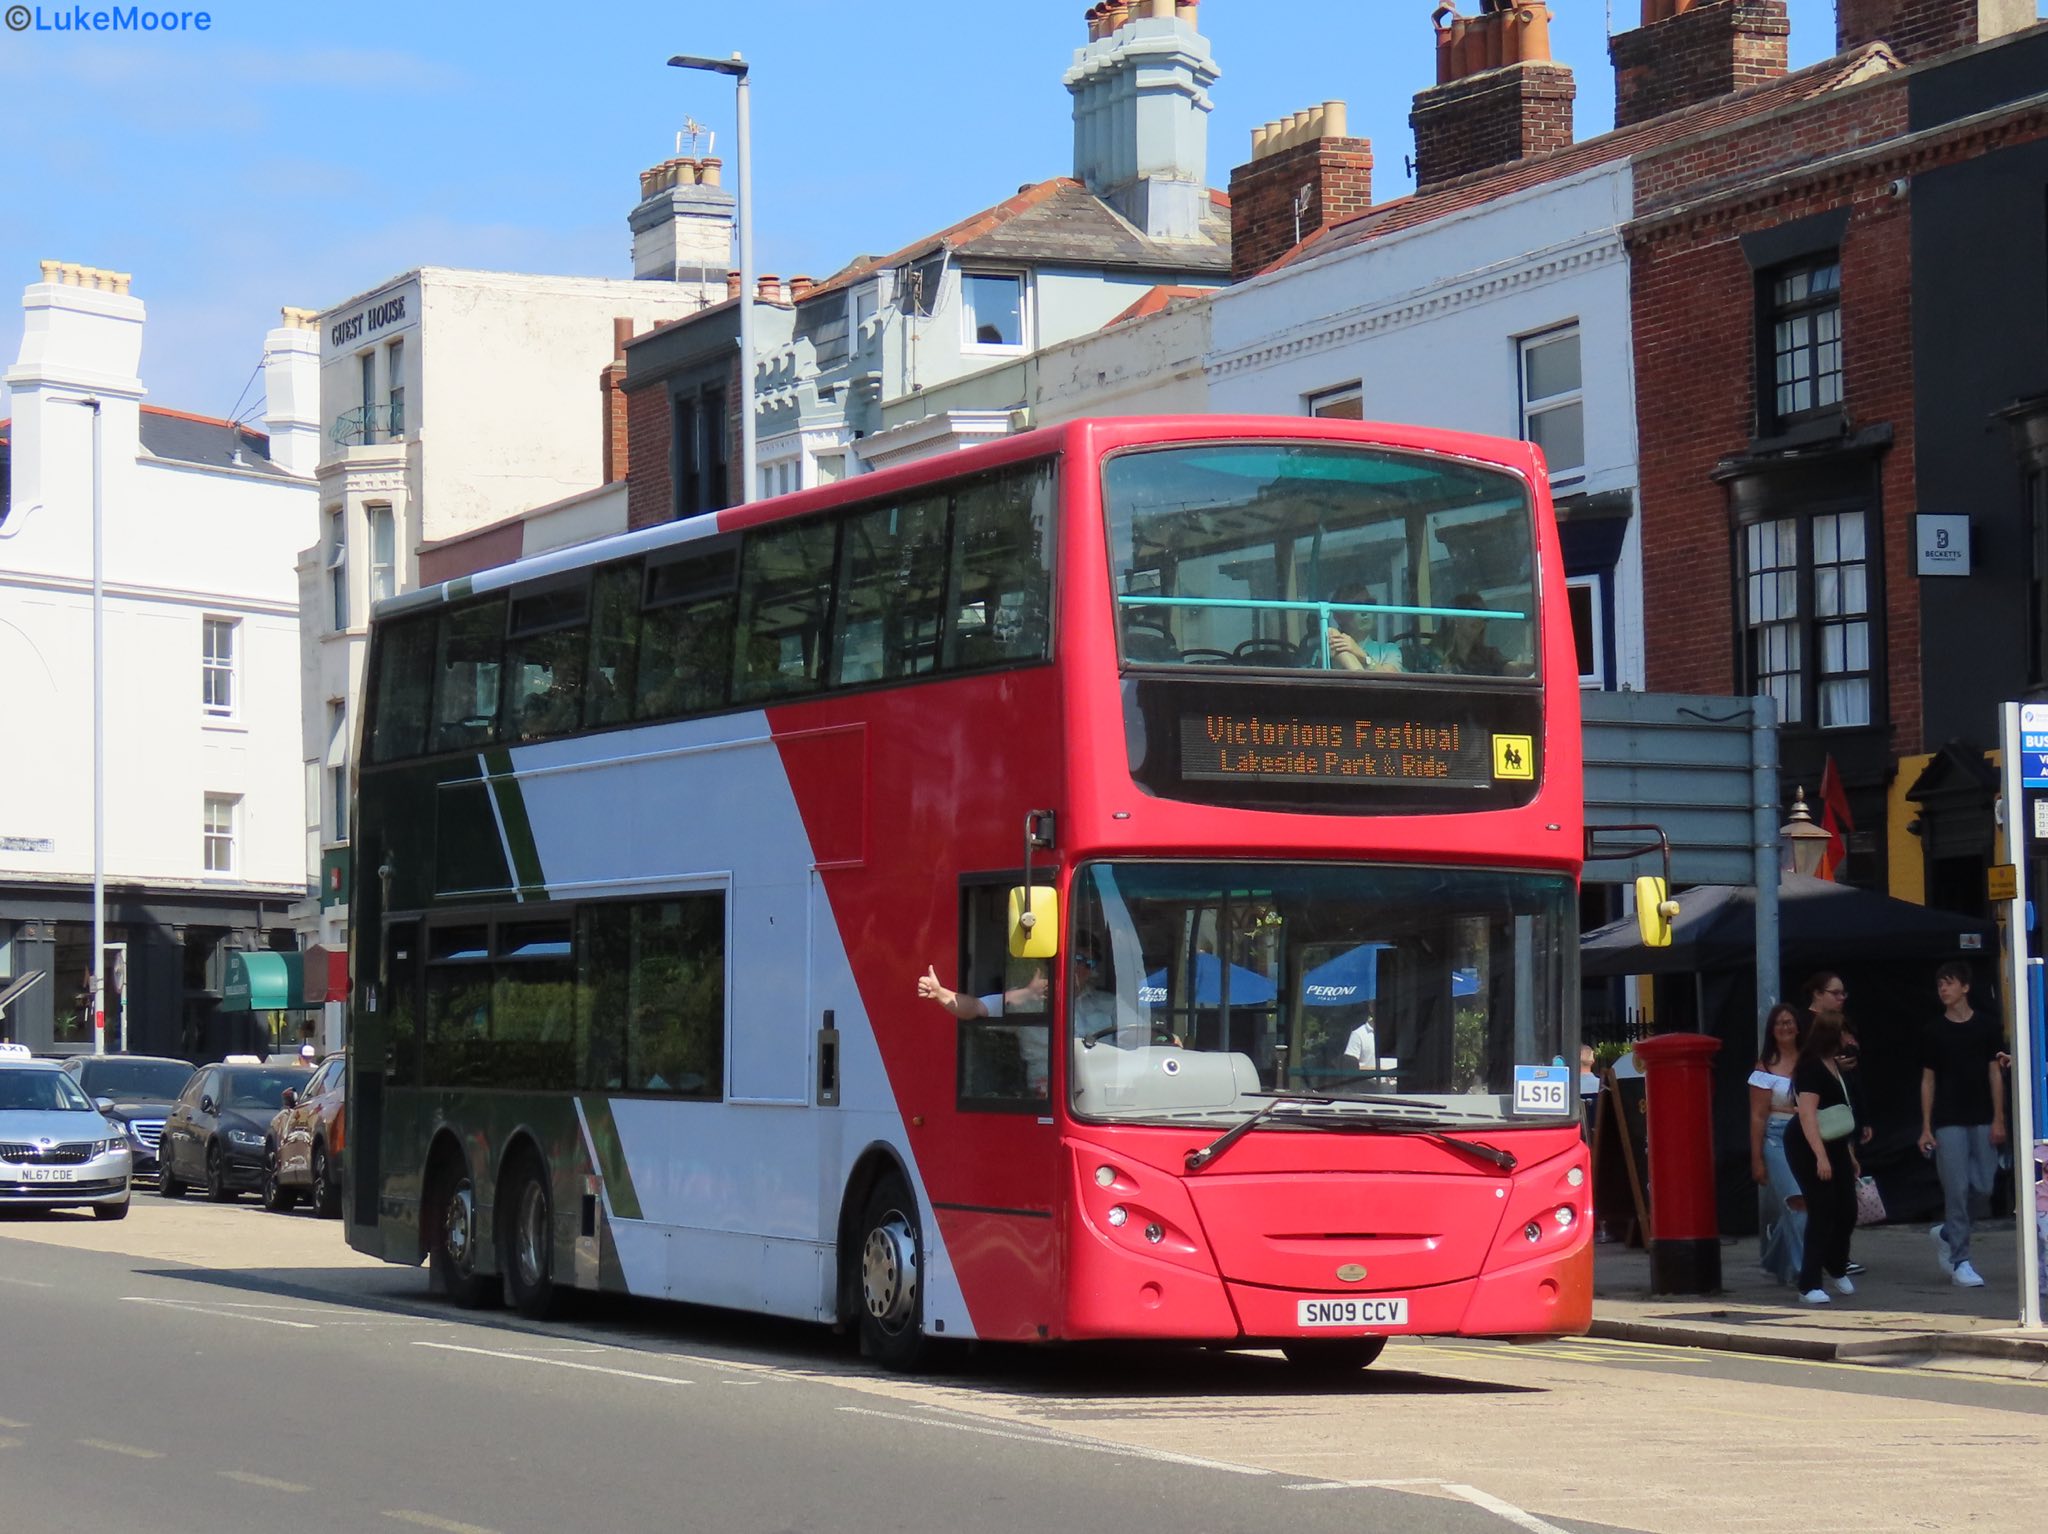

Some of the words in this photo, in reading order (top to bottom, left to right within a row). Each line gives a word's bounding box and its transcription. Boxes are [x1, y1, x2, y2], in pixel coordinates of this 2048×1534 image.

[332, 312, 363, 347] GUEST
[368, 296, 406, 331] HOUSE
[1925, 550, 1962, 558] BECKETTS
[1207, 715, 1343, 747] Victorious
[1355, 720, 1459, 751] Festival
[1220, 749, 1318, 774] Lakeside
[1325, 752, 1377, 775] Park
[1383, 754, 1396, 775] &
[1402, 754, 1448, 777] Ride
[1306, 985, 1358, 996] PERONI
[1521, 1085, 1562, 1103] LS16
[22, 1170, 49, 1180] NL67
[53, 1170, 73, 1180] CDE
[1307, 1303, 1356, 1322] SN09
[1362, 1302, 1399, 1321] CCV
